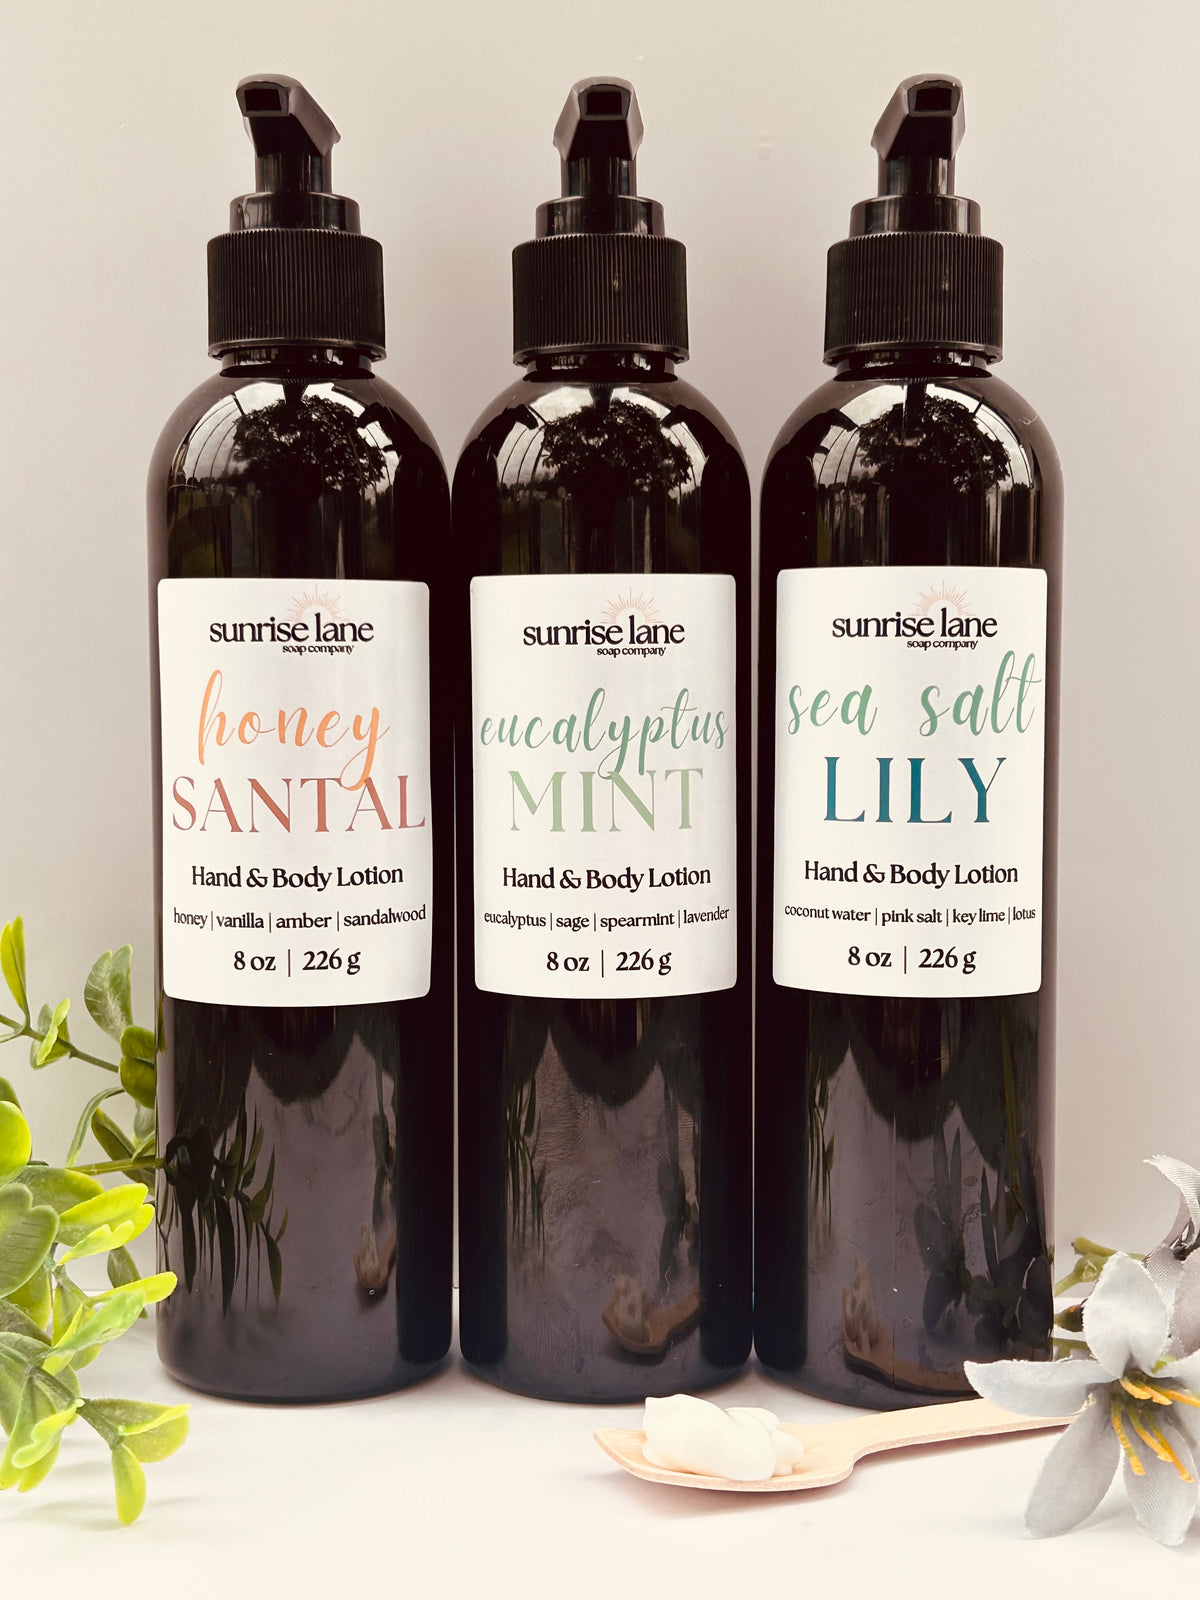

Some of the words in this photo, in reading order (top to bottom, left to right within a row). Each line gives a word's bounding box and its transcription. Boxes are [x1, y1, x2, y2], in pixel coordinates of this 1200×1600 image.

[209, 616, 309, 642] sunrise
[315, 612, 374, 642] lane
[523, 620, 623, 645] sunrise
[629, 615, 685, 644] lane
[832, 612, 934, 637] sunrise
[940, 608, 997, 637] lane
[282, 645, 307, 655] soap
[308, 645, 354, 655] company
[597, 647, 620, 658] soap
[622, 647, 666, 657] company
[907, 640, 931, 651] soap
[933, 640, 978, 650] company
[788, 684, 877, 735] sea
[919, 651, 1042, 736] salt
[198, 669, 390, 791] honey
[480, 688, 729, 779] eucalyptus
[172, 775, 425, 832] SANTAL
[508, 768, 703, 832] MINT
[824, 757, 1007, 823] LILY
[192, 866, 242, 887] Hand
[246, 868, 268, 888] &
[273, 866, 332, 891] Body
[337, 866, 403, 886] Lotion
[503, 867, 555, 888] Hand
[560, 870, 581, 888] &
[586, 867, 644, 893] Body
[649, 867, 711, 887] Lotion
[805, 860, 858, 882] Hand
[863, 864, 885, 883] &
[890, 862, 950, 889] Body
[954, 865, 1018, 884] Lotion
[174, 907, 208, 929] honey
[216, 912, 264, 928] vanilla
[276, 913, 332, 928] amber
[343, 904, 426, 926] sandalwood
[484, 911, 546, 929] eucalyptus
[556, 916, 590, 931] sage
[600, 912, 674, 931] spearmint
[683, 906, 729, 924] lavender
[784, 905, 829, 919] coconut
[832, 909, 871, 921] water
[882, 909, 913, 926] pink
[917, 909, 942, 923] salt
[953, 909, 977, 925] key
[979, 908, 1005, 921] lime
[1013, 906, 1035, 920] lotus
[234, 951, 245, 970] 8
[250, 955, 276, 970] oz
[302, 948, 342, 970] 226
[347, 952, 361, 975] g
[547, 951, 559, 970] 8
[564, 956, 590, 971] oz
[616, 948, 654, 971] 226
[659, 952, 672, 975] g
[848, 946, 860, 965] 8
[866, 951, 892, 967] oz
[918, 946, 958, 968] 226
[963, 951, 976, 974] g
